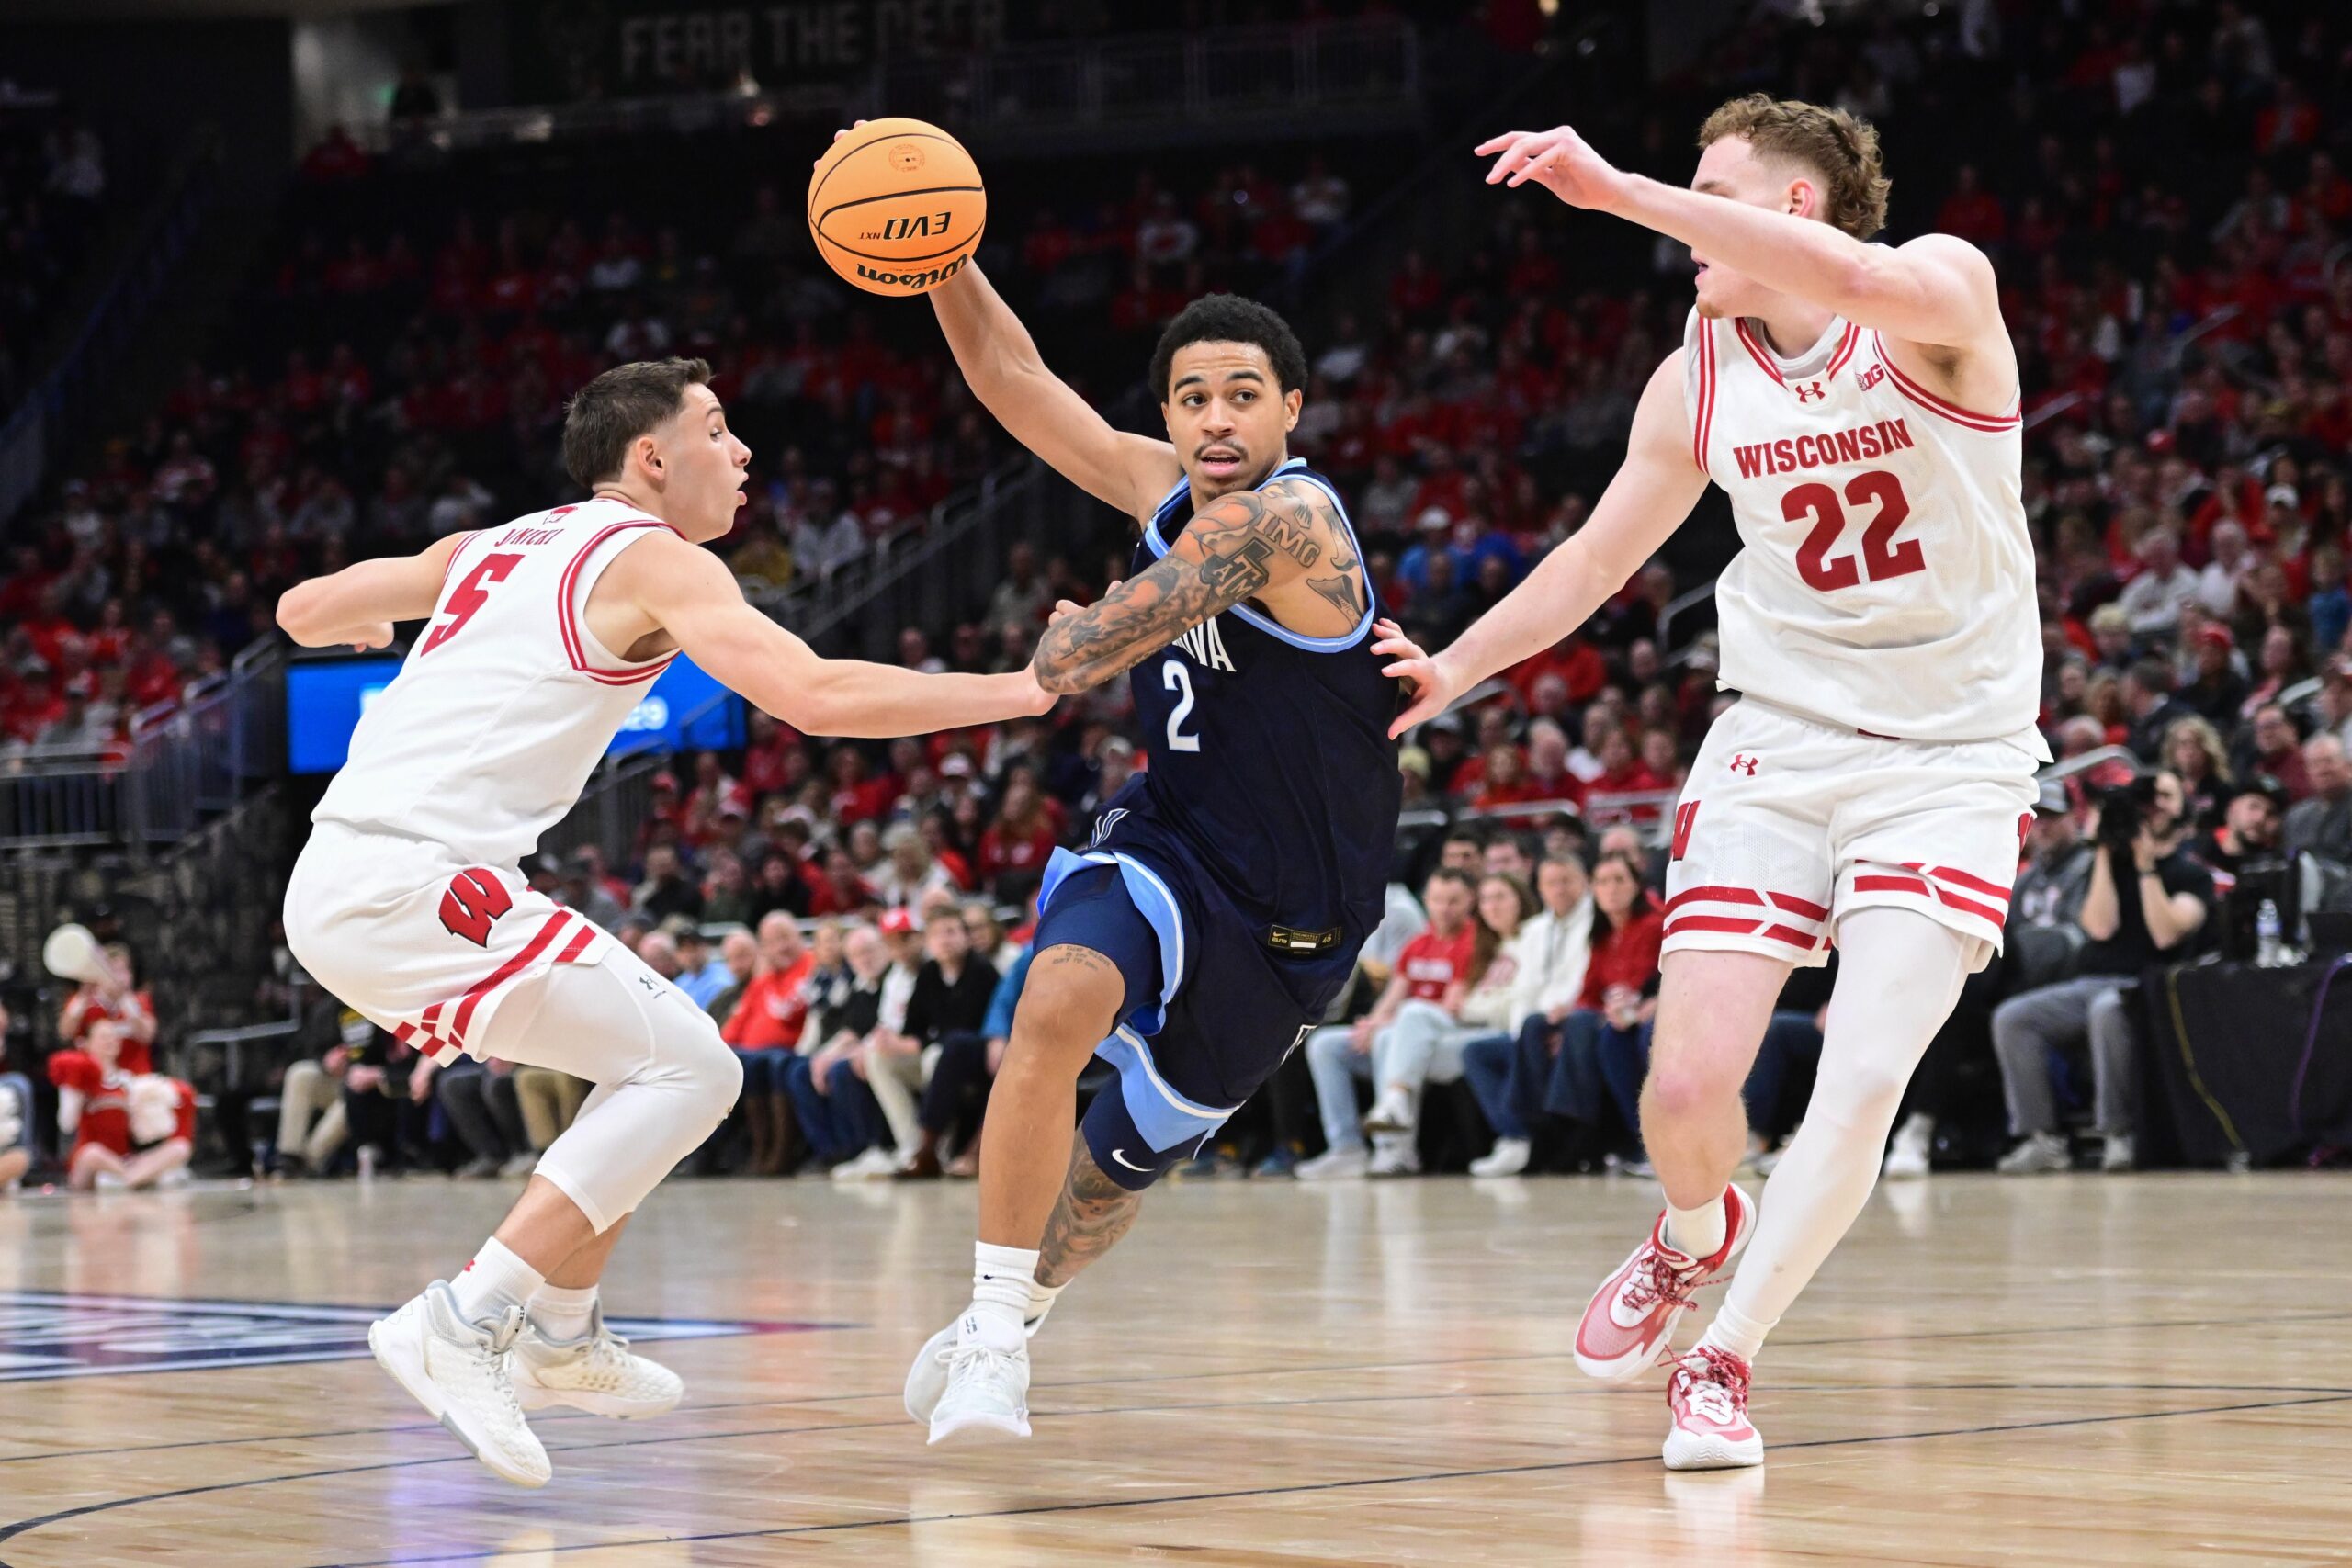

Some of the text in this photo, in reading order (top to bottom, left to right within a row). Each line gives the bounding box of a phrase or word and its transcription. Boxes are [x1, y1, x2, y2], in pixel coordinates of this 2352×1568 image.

[621, 12, 752, 81] FEAR
[763, 4, 864, 68] THE
[856, 253, 968, 289] Wilson
[1733, 418, 1915, 479] WISCONSIN
[1253, 508, 1321, 568] IMG
[1781, 470, 1927, 592] 22
[420, 553, 526, 658] 5
[1161, 660, 1201, 752] 2
[438, 867, 514, 949] W
